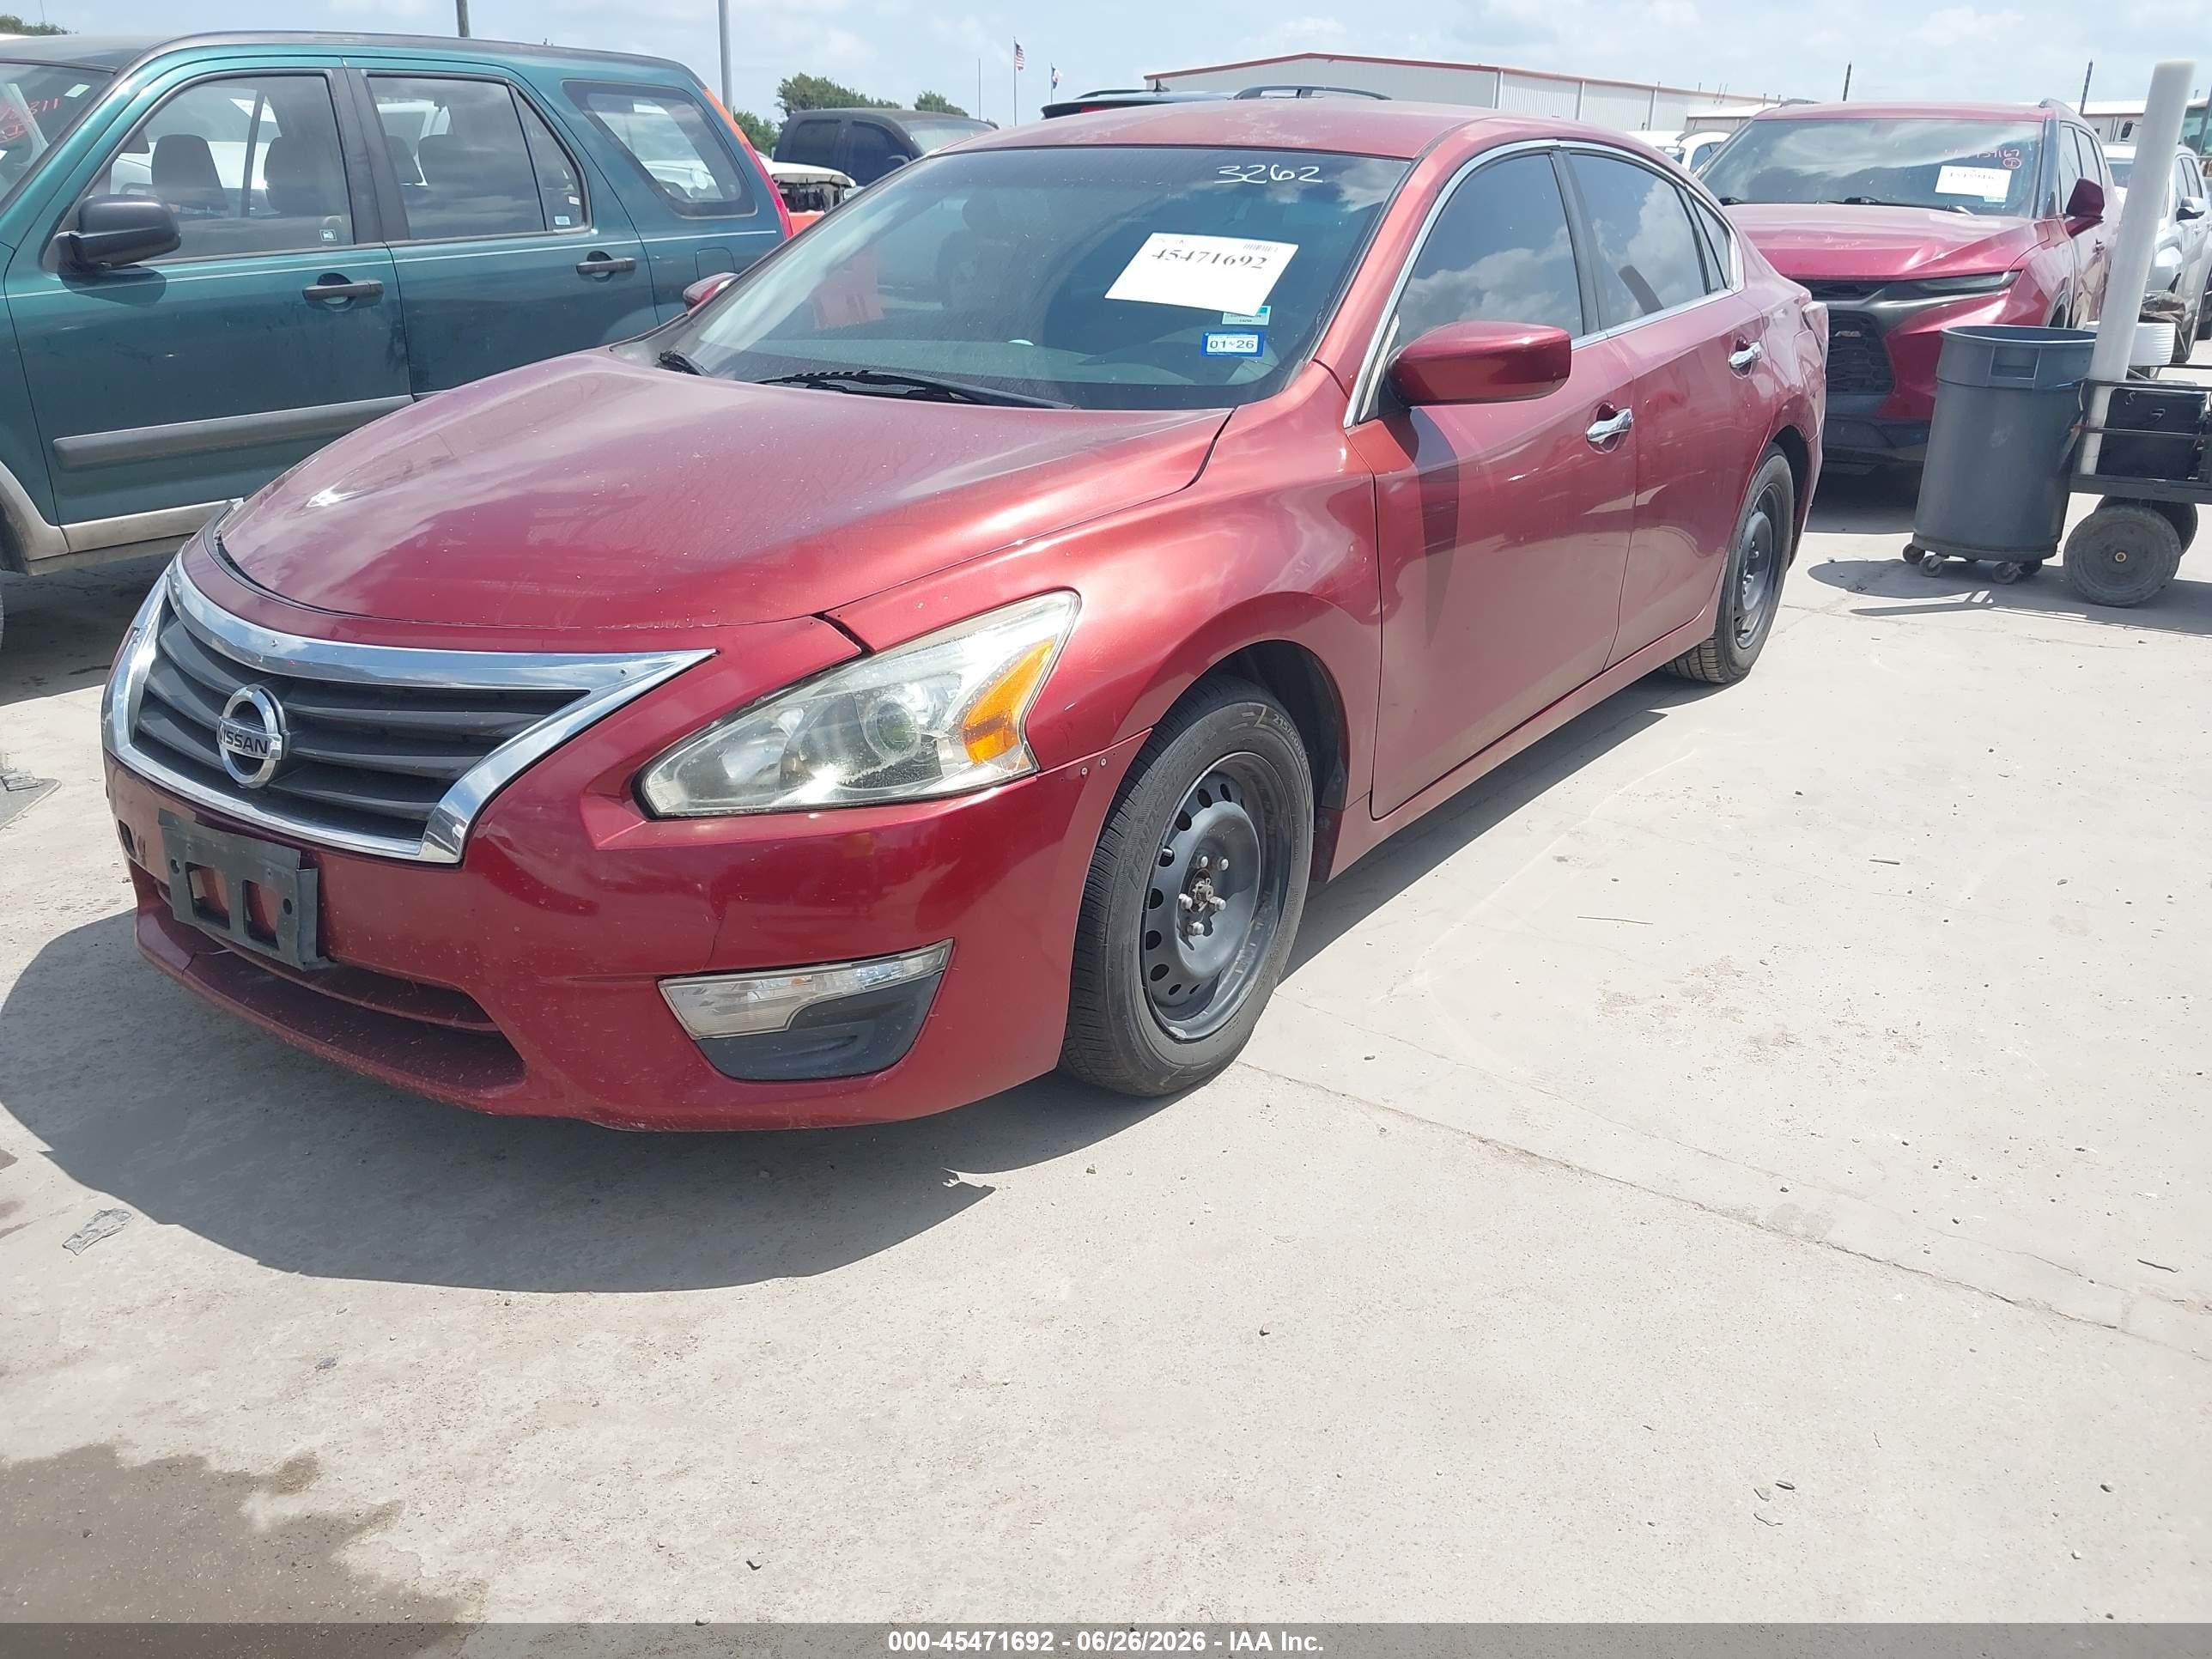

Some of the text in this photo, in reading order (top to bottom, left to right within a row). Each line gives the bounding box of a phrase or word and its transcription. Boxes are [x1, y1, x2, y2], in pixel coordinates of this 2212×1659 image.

[1213, 164, 1324, 184] 3262
[1152, 248, 1268, 270] 45471692
[218, 726, 269, 754] NISSAN
